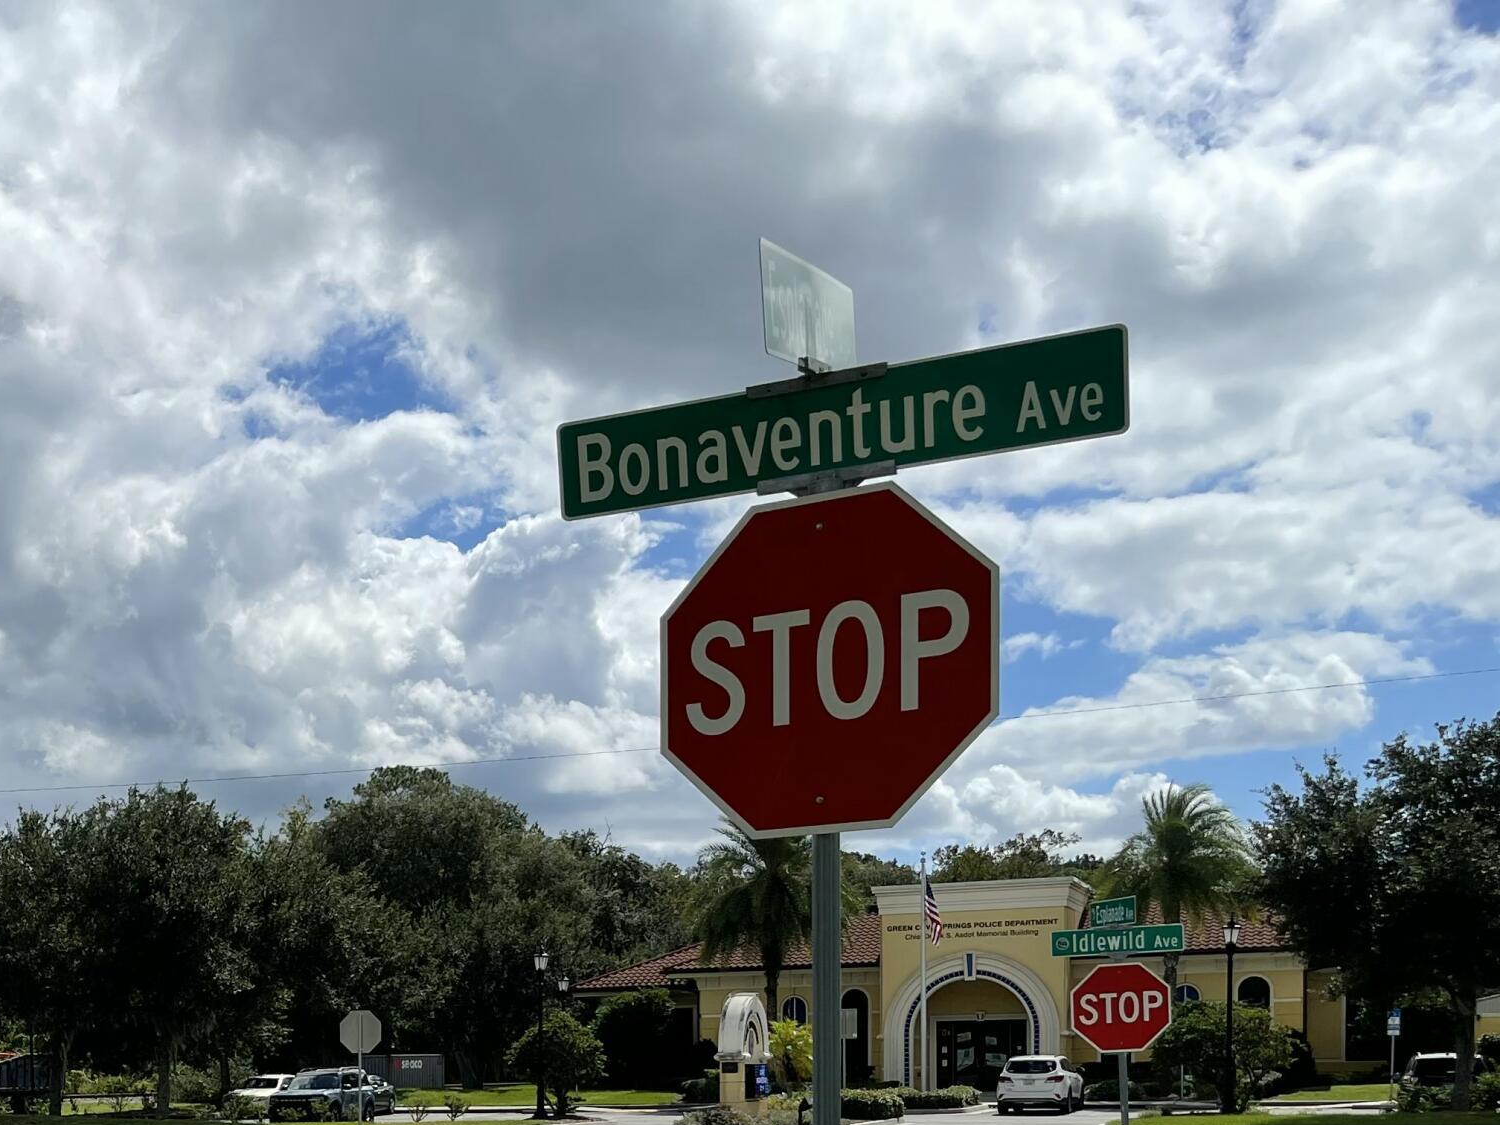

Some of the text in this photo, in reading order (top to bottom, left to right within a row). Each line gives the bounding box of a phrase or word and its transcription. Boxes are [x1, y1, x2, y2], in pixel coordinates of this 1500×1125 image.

[576, 381, 1104, 504] Bonaventure Ave
[685, 588, 971, 736] STOP
[886, 924, 913, 933] GREEN
[942, 921, 972, 931] PRINGS
[973, 919, 1003, 929] POLICE
[1004, 917, 1059, 928] DEPARTMENT
[976, 928, 1009, 938] Memorial
[1010, 927, 1039, 937] Building
[1072, 930, 1179, 953] Idlewild Ave
[1078, 989, 1164, 1026] STOP
